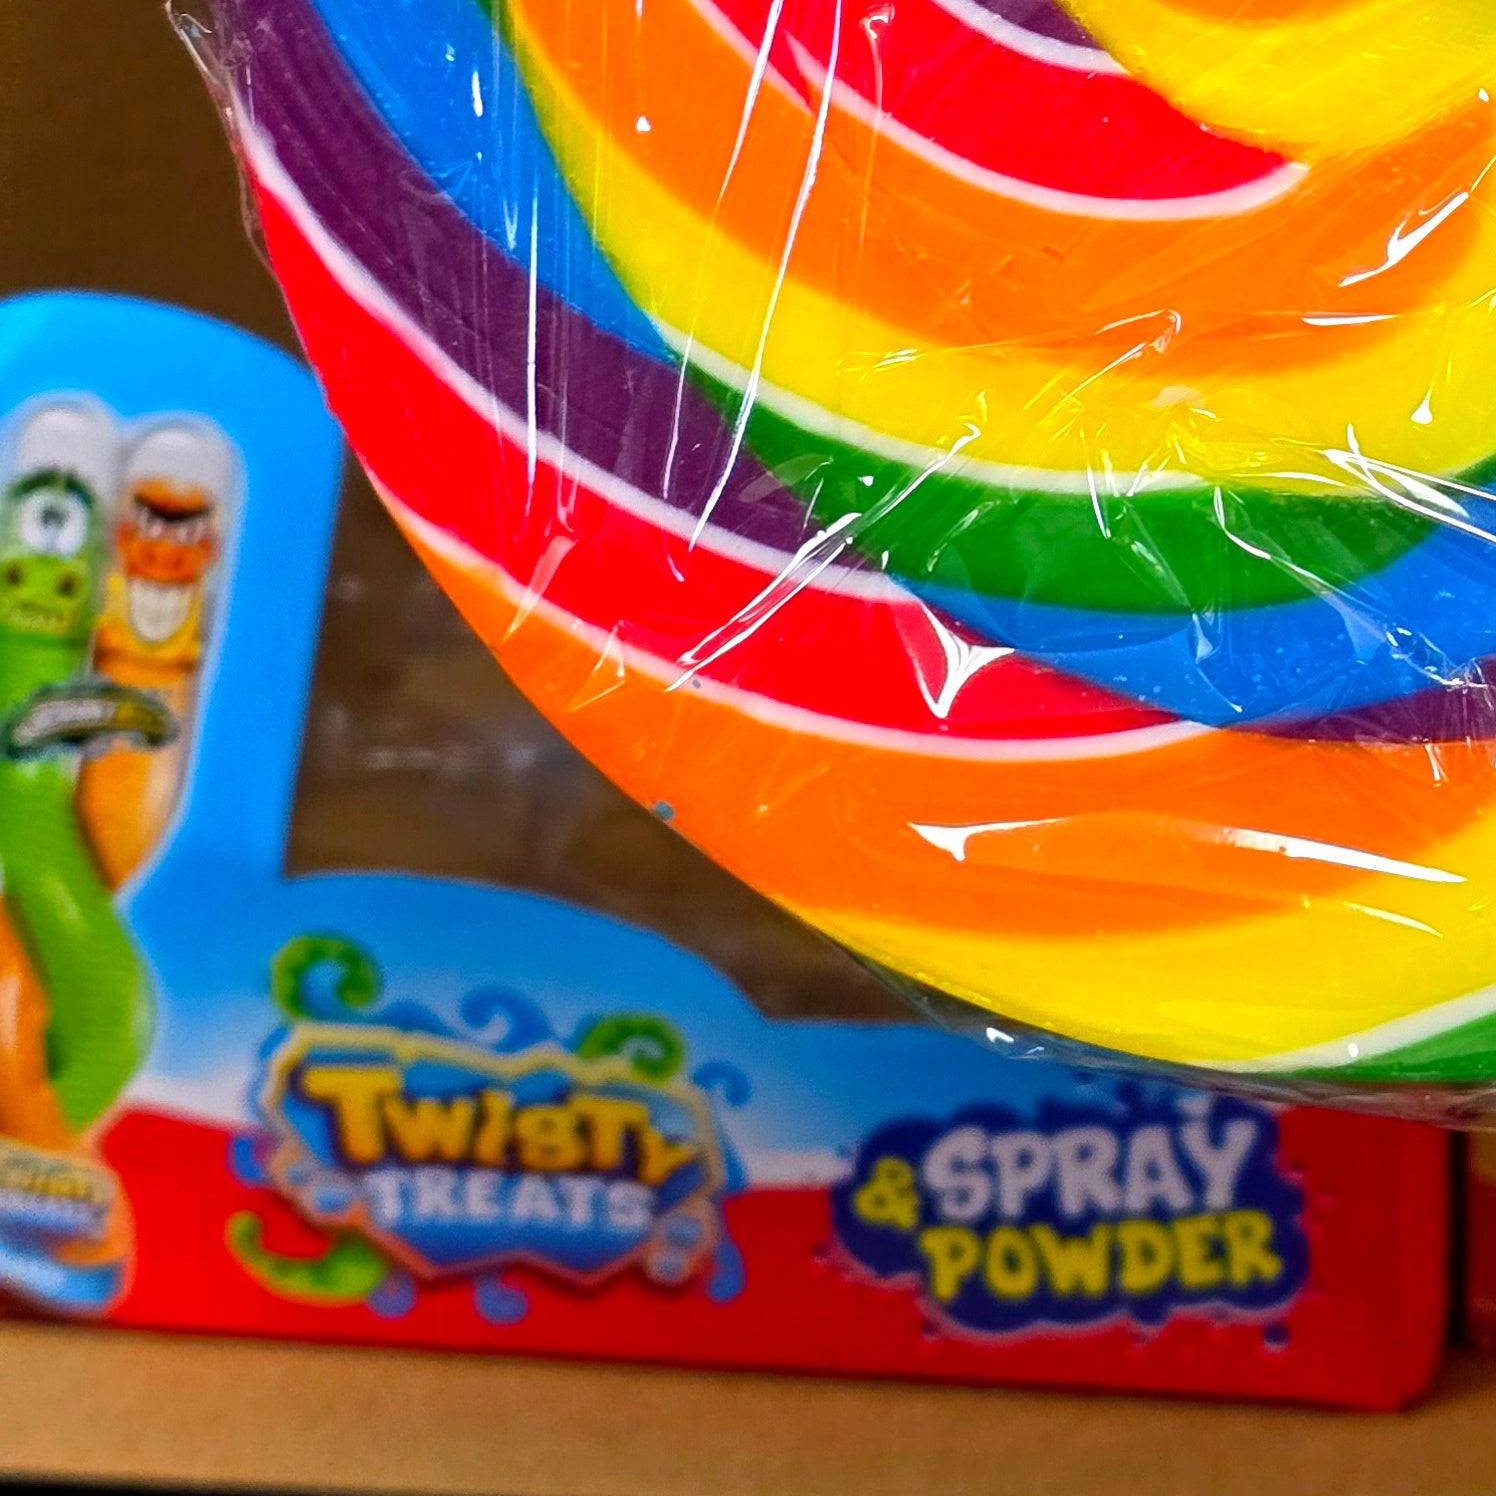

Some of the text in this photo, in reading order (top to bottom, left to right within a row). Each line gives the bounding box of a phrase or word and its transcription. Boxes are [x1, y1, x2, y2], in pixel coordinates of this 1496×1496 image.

[364, 1168, 656, 1236] TREATS
[854, 1118, 1258, 1229] & SPRAY
[920, 1209, 1282, 1300] POWDER
